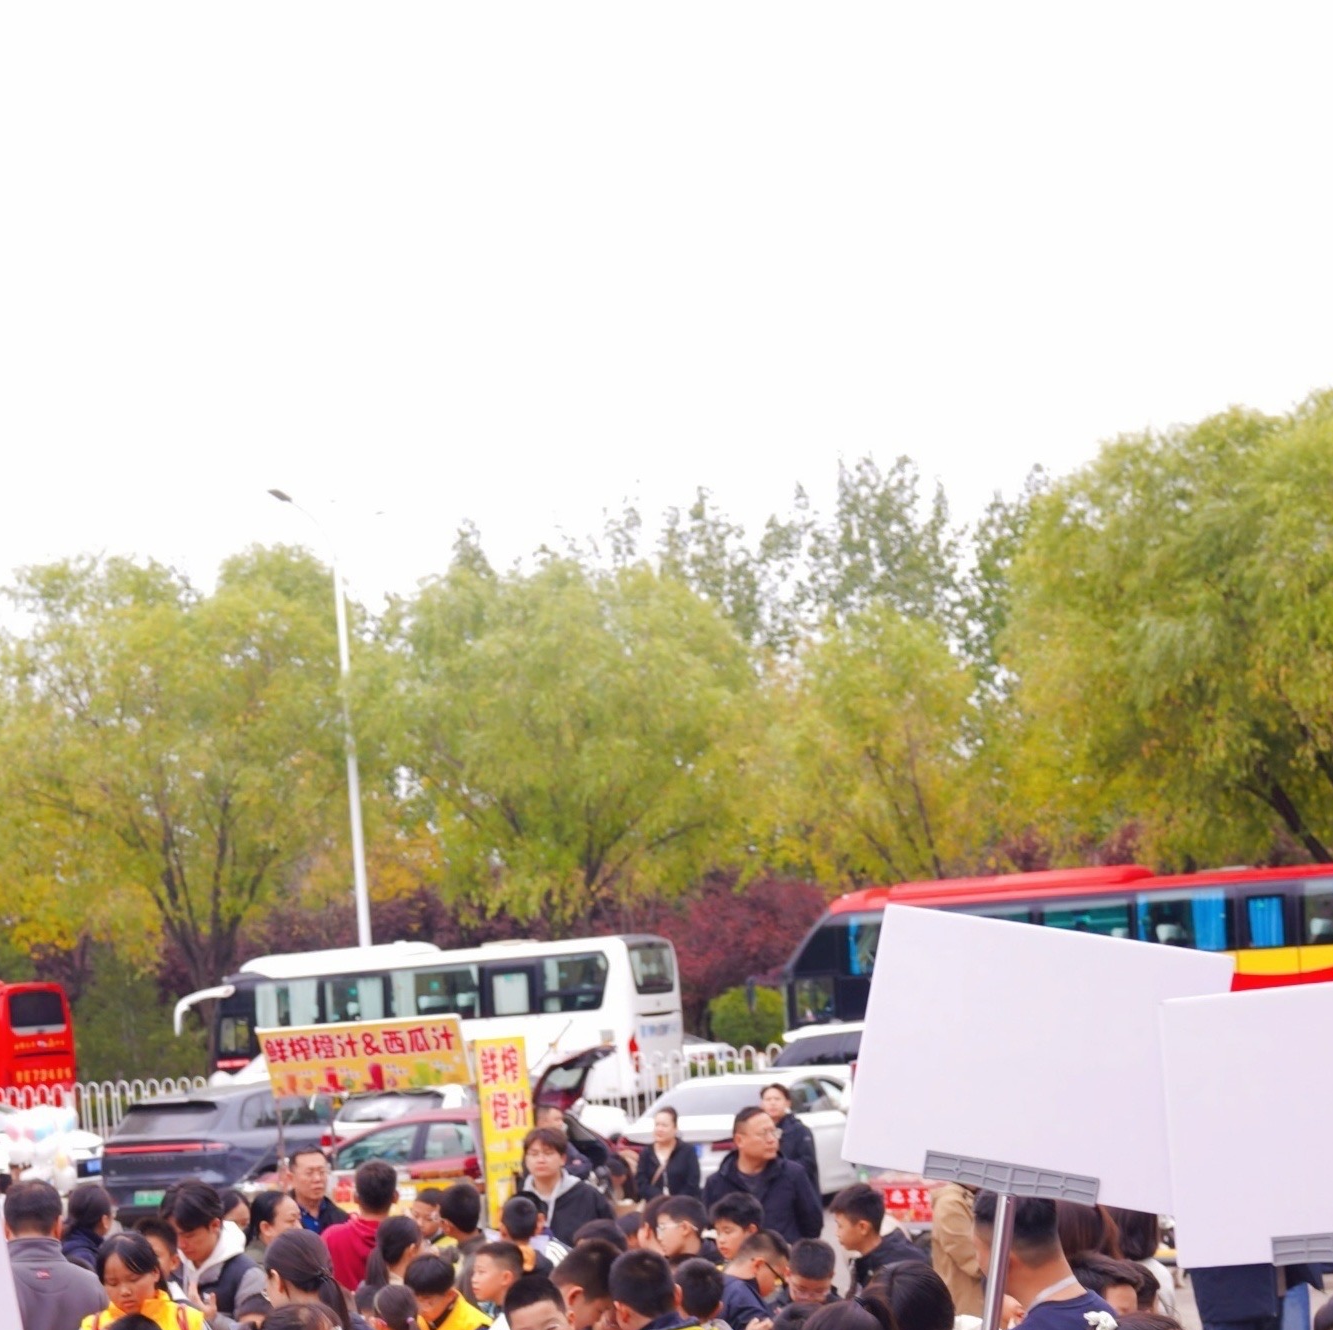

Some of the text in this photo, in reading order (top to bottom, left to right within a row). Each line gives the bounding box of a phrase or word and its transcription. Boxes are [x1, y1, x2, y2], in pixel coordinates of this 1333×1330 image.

[264, 1025, 455, 1064] 鲜榨橙汁&西瓜汁
[480, 1045, 519, 1086] 鲜榨
[492, 1088, 528, 1130] 橙汁
